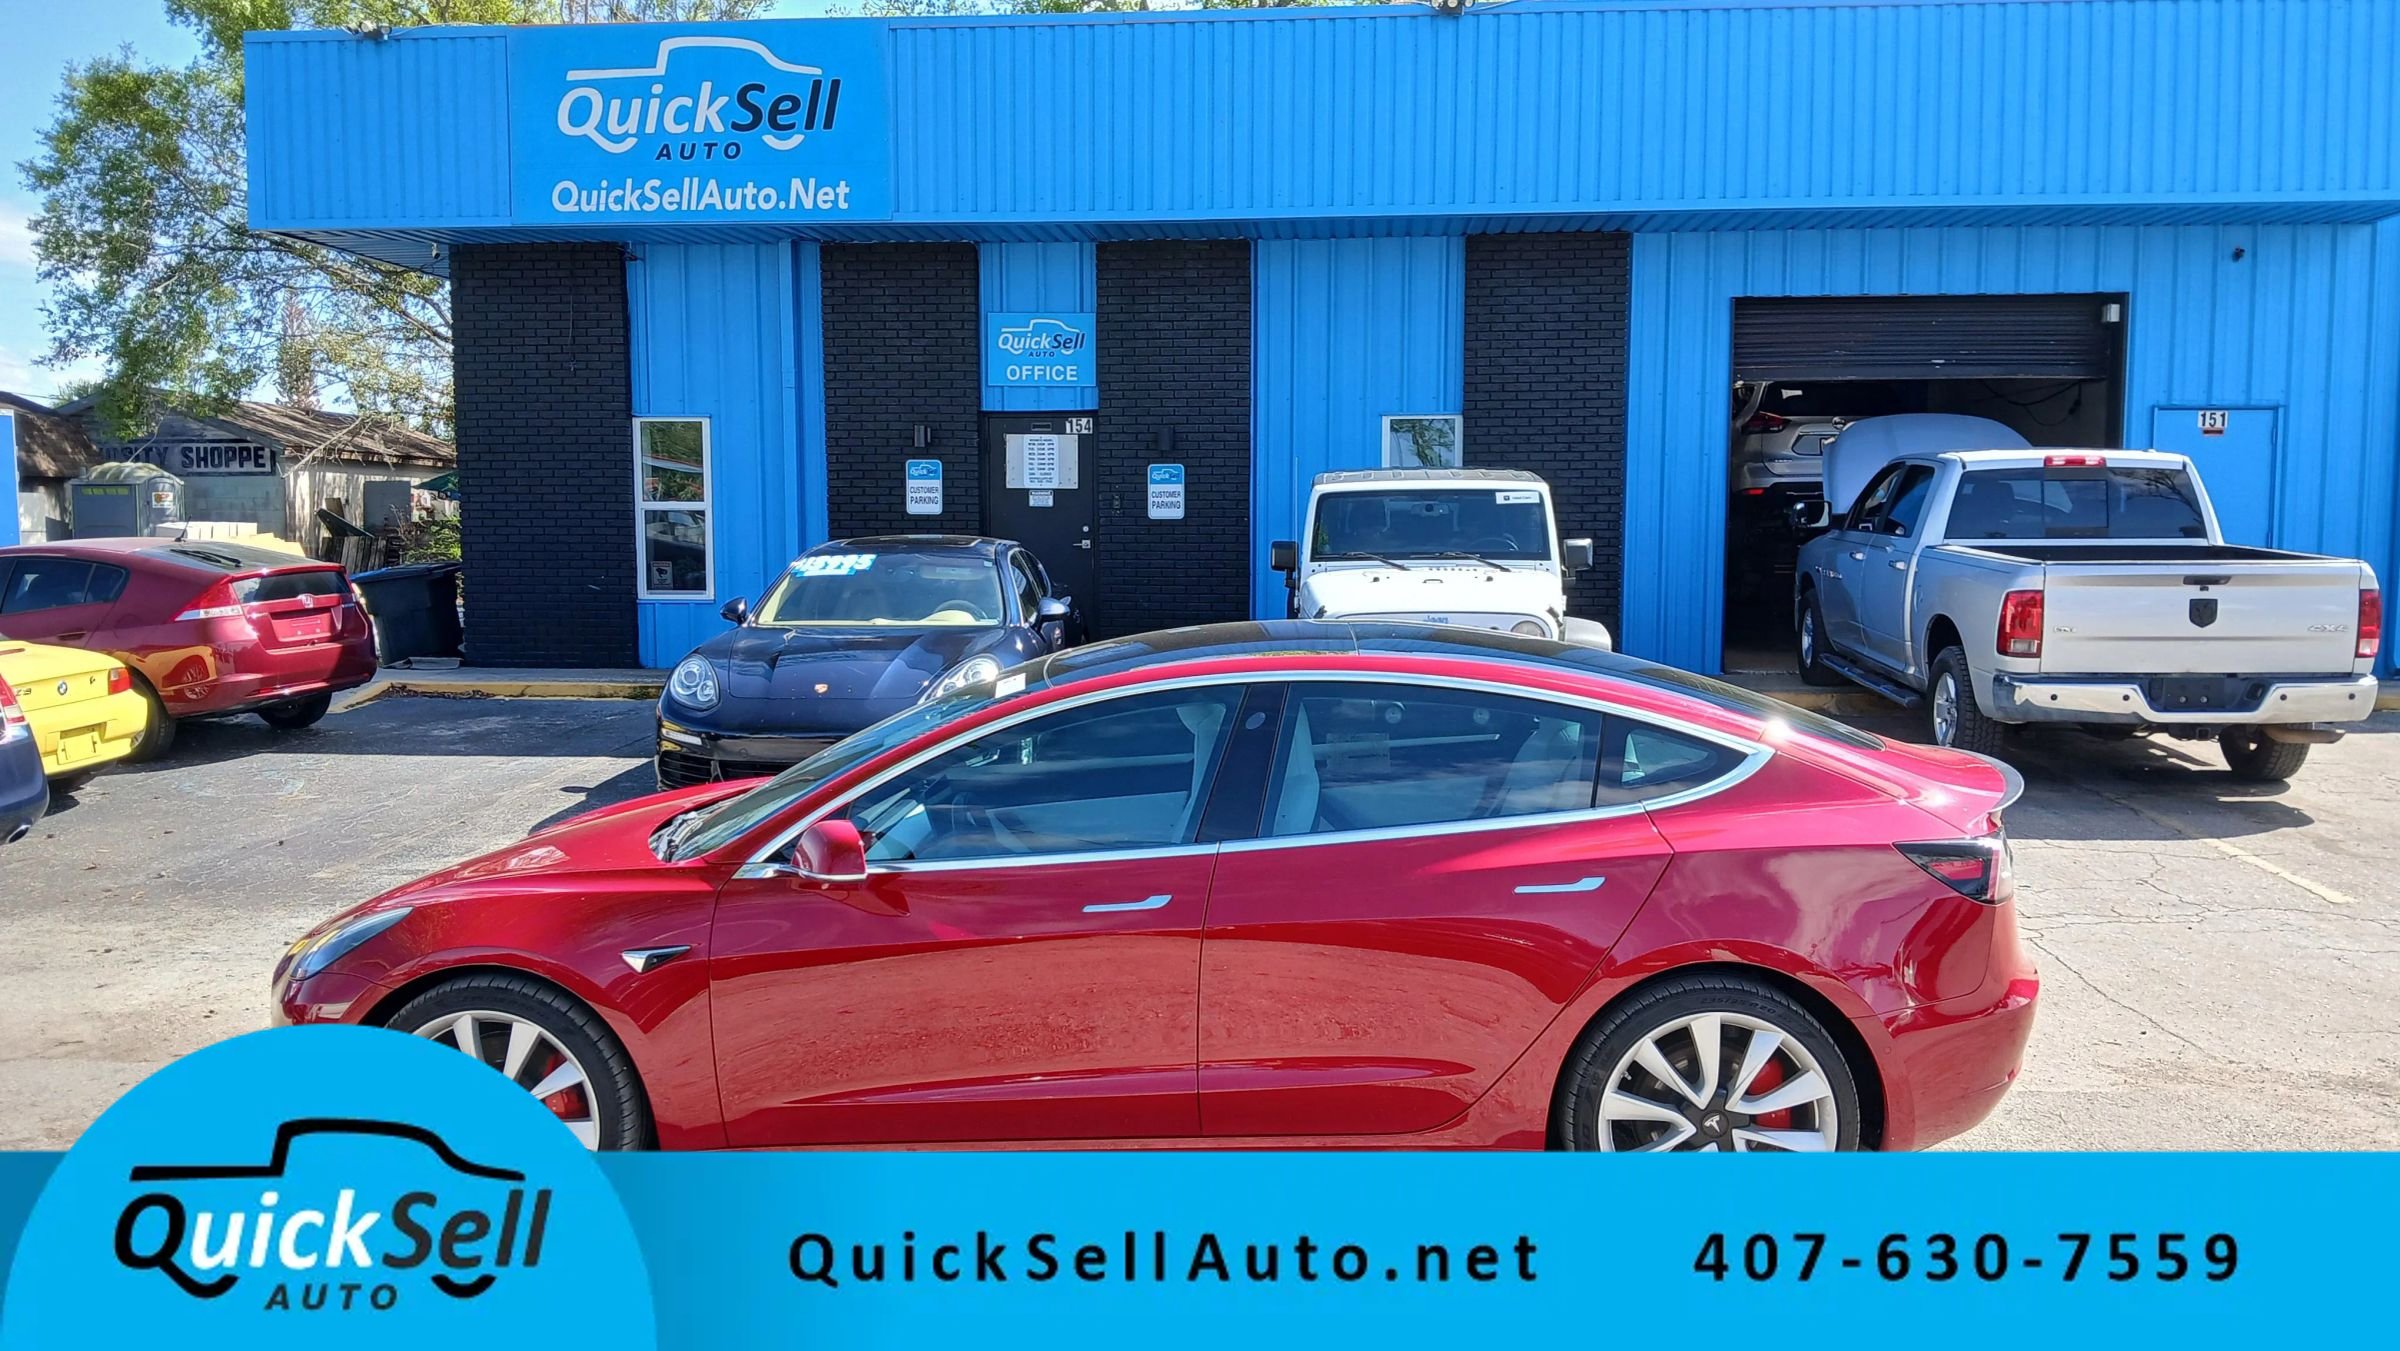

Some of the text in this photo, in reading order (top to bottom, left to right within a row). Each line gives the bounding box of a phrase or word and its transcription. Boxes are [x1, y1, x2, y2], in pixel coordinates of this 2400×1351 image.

[557, 78, 842, 154] QuickSell
[655, 142, 743, 161] AUTO
[551, 177, 850, 213] QuickSellAuto.Net
[998, 332, 1086, 355] QuickSell
[1006, 365, 1078, 381] OFFICE
[1067, 418, 1092, 433] 154
[2200, 411, 2226, 428] 151
[181, 446, 266, 469] SHOPPE
[910, 486, 939, 494] CUSTOMER
[1151, 490, 1181, 498] CUSTOMER
[910, 496, 939, 505] PARKING
[1151, 500, 1181, 510] PARKING
